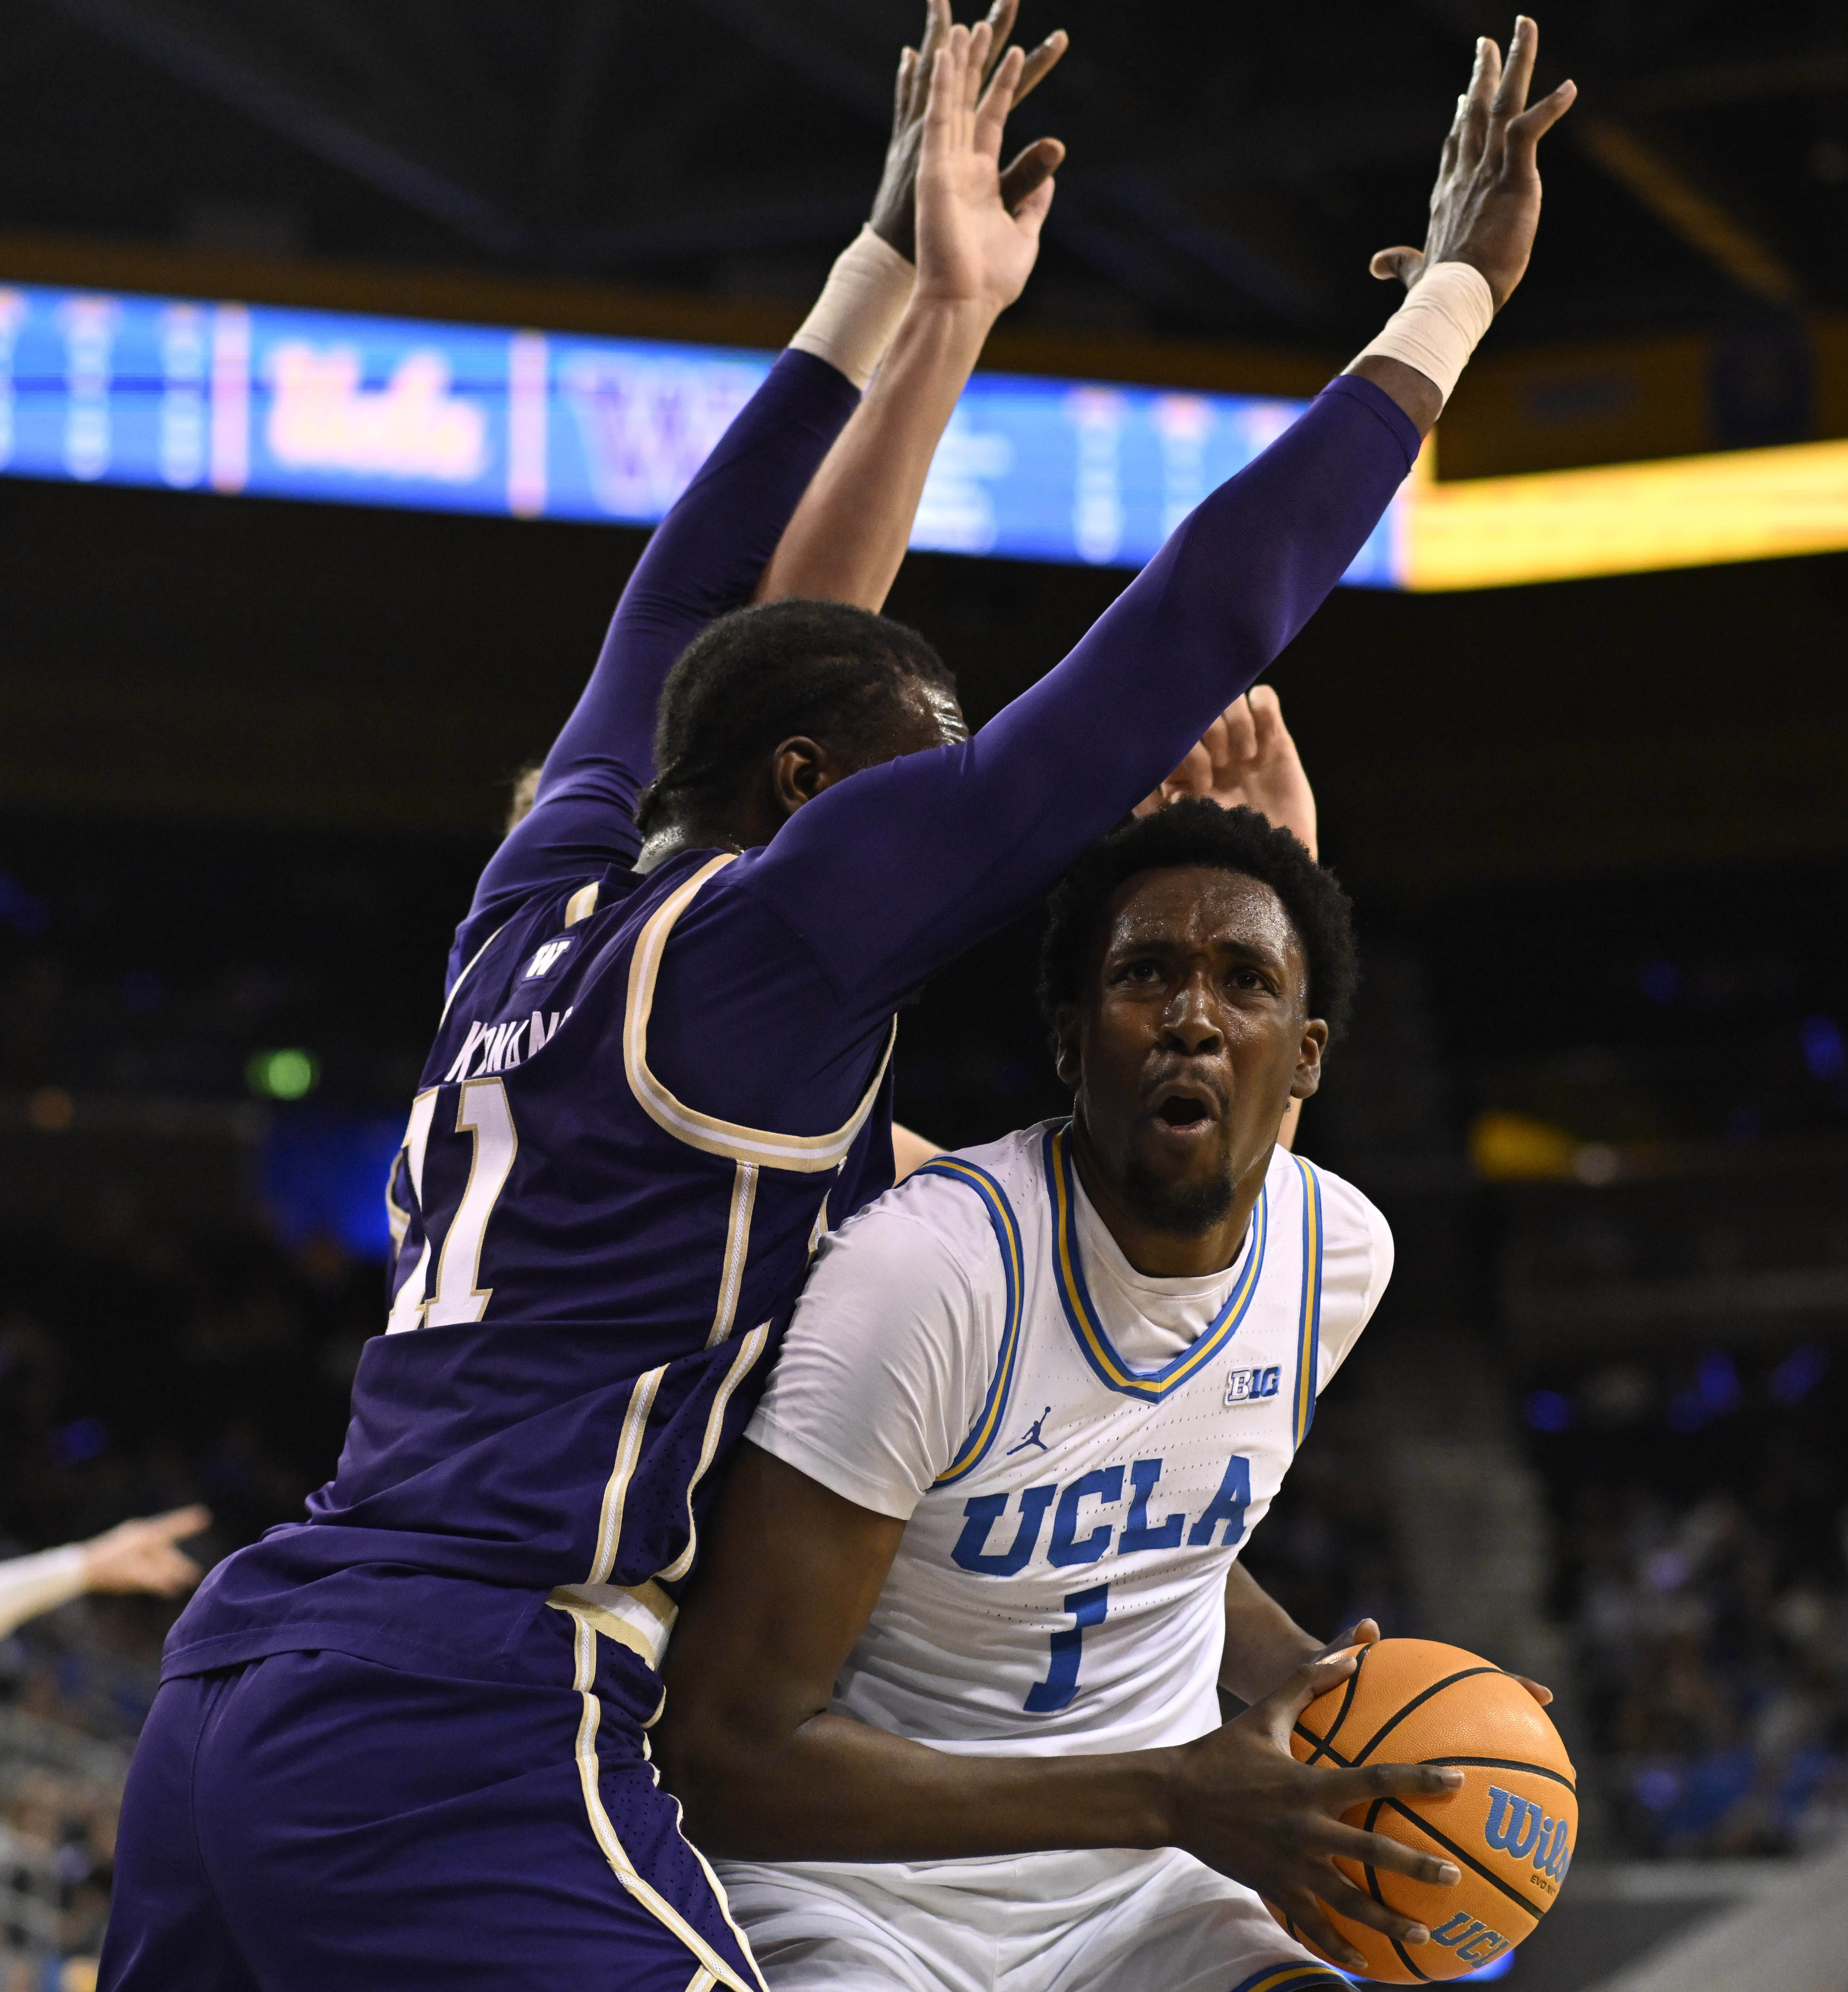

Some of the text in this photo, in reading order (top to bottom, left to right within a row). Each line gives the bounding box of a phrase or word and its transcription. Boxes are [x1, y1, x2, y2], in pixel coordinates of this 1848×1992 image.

[526, 941, 571, 978] W
[1228, 1366, 1281, 1401] BIG
[951, 1455, 1251, 1577] UCLA
[1023, 1583, 1109, 1712] 1
[1530, 1875, 1547, 1889] EVO
